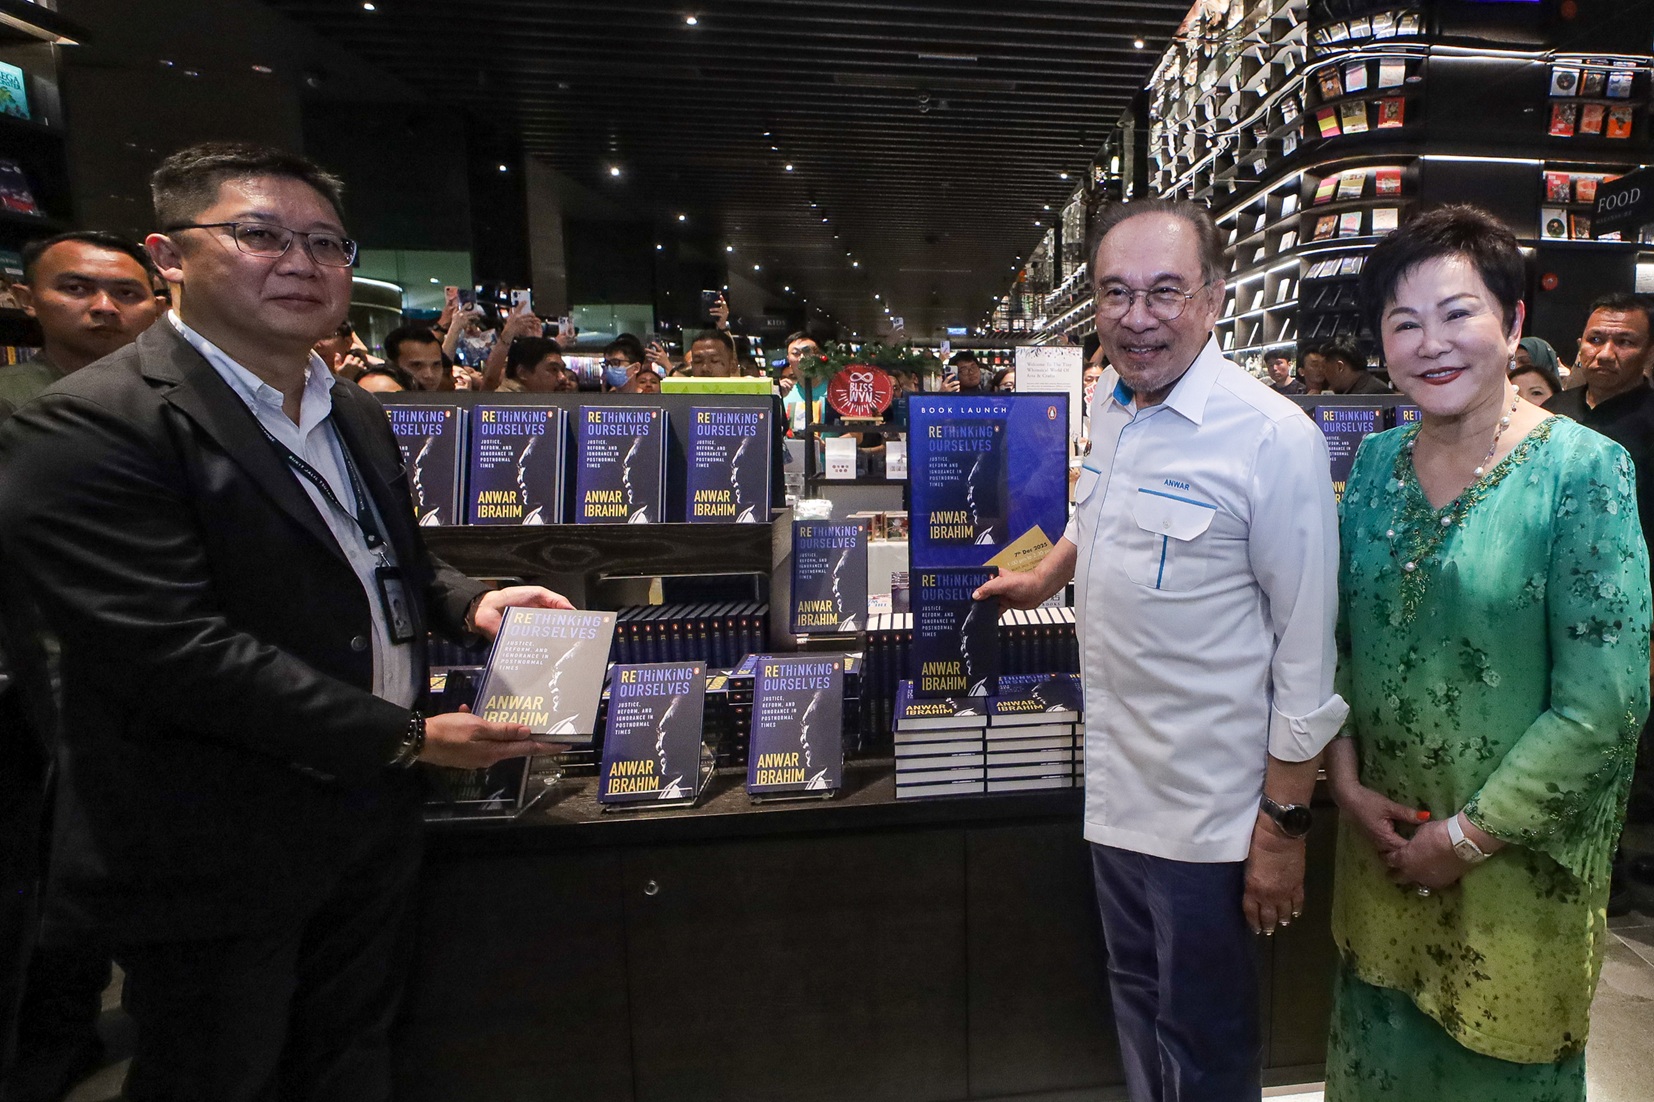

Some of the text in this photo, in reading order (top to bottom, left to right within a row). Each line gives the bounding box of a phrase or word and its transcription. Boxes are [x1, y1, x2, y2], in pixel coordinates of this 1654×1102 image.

[1597, 188, 1640, 213] FOOD
[850, 382, 873, 392] BLISS
[850, 391, 873, 402] WYN
[393, 424, 442, 435] RSELVES
[482, 424, 545, 435] OURSELVES
[588, 424, 649, 436] OURSELVES
[697, 425, 756, 436] OURSELVES
[1323, 422, 1374, 432] OURSELVES
[929, 440, 992, 451] OURSELVES
[1164, 479, 1190, 490] ANWAR
[478, 491, 517, 504] ANWAR
[584, 490, 622, 503] ANWAR
[694, 490, 730, 502] ANWAR
[478, 505, 522, 518] IBRAHIM
[584, 504, 628, 517] IBRAHIM
[694, 504, 736, 516] IBRAHIM
[930, 511, 967, 524] ANWAR
[930, 525, 974, 539] IBRAHIM
[800, 538, 856, 549] OURSELVES
[922, 589, 972, 600] OURSELV
[798, 600, 832, 613] ANWAR
[798, 613, 838, 626] IBRAHIM
[510, 625, 597, 639] OURSELVES
[922, 661, 960, 675] ANWAR
[620, 682, 690, 697] OURSELVES
[764, 677, 830, 691] OURSELVES
[922, 676, 967, 690] IBRAHIM
[485, 695, 544, 710] ANWAR
[757, 753, 799, 768] ANWAR
[609, 760, 654, 777] ANWAR
[757, 768, 805, 784] IBRAHIM
[608, 776, 659, 793] IBRAHIM
